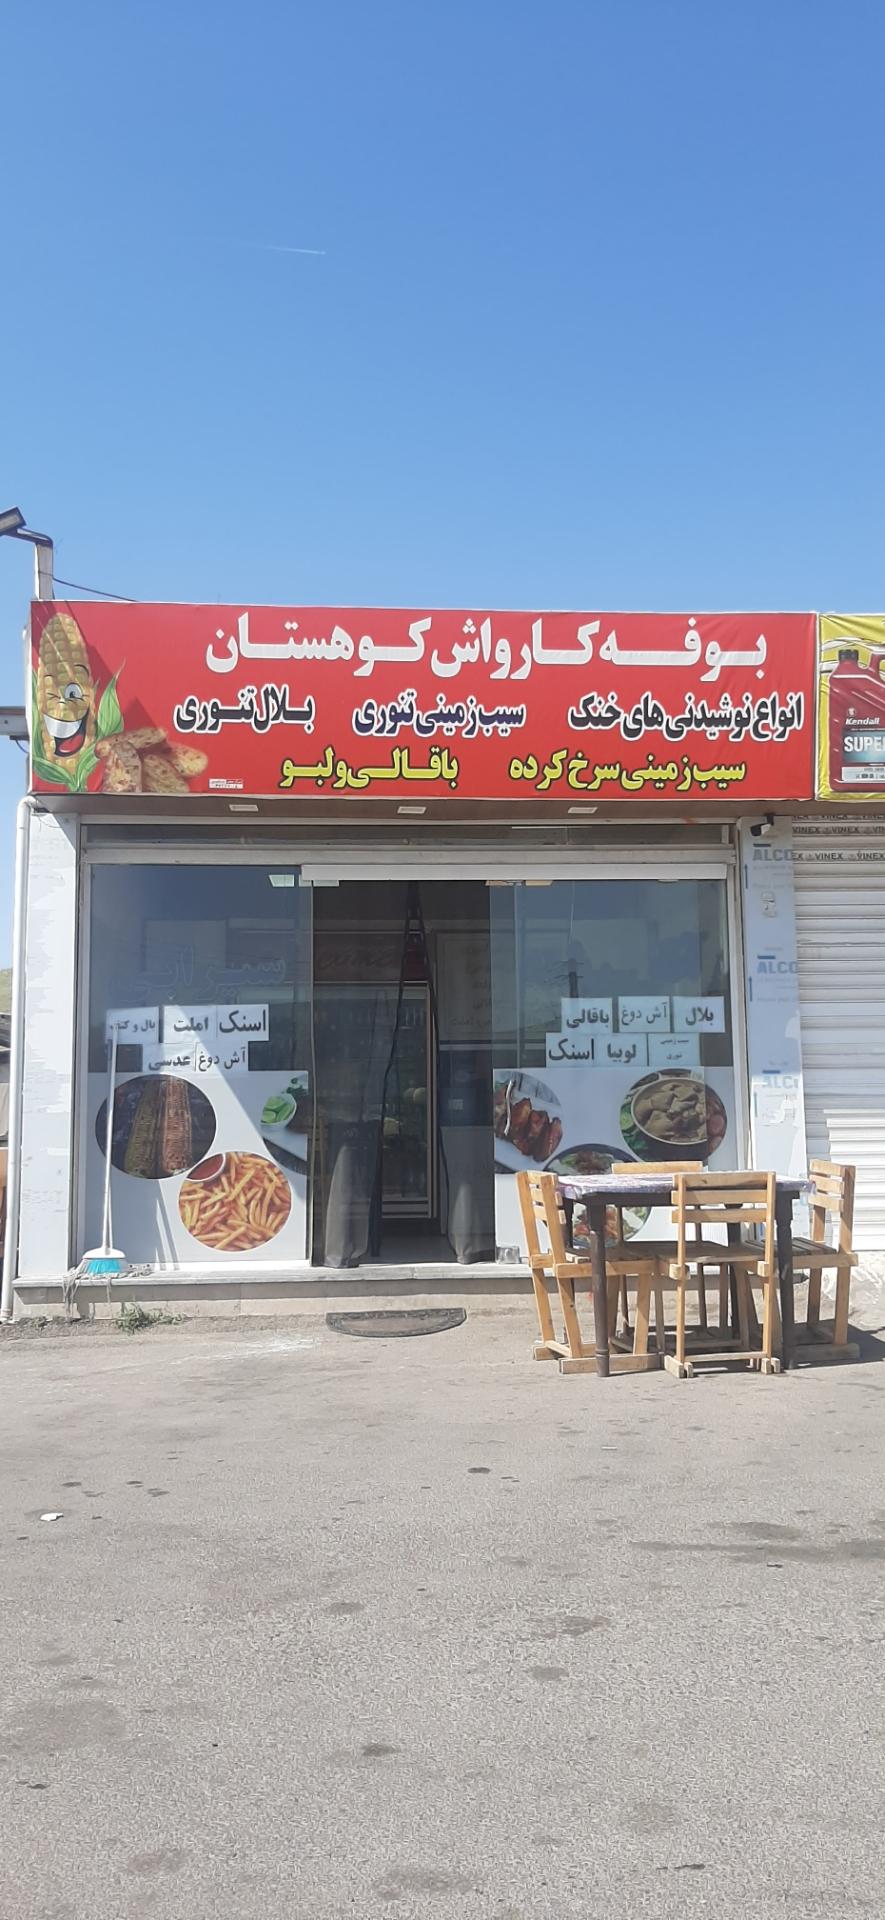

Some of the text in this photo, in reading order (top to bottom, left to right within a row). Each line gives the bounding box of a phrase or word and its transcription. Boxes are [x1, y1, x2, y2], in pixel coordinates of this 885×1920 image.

[205, 611, 767, 682] بوفه کارواش کوهستان
[173, 683, 315, 735] بلال تنوری
[352, 688, 527, 738] سیب زمینی تنوری
[567, 691, 805, 742] انواع نوشیدنی های خنک
[845, 717, 881, 726] Kendall
[844, 736, 885, 753] SUPE
[347, 746, 460, 789] باقالی
[509, 749, 747, 791] سیب زمینی سرخ کرده
[831, 826, 860, 835] VINEX
[815, 852, 844, 861] VINEX
[172, 1015, 209, 1033] املت
[218, 1008, 267, 1034] اسنک
[566, 1007, 610, 1029] باقالی
[620, 1001, 667, 1026] آش دوغ
[685, 1006, 714, 1027] بلال
[198, 1046, 247, 1071] آش دوغ
[548, 1038, 595, 1061] اسنک
[607, 1043, 637, 1064] لوبیا
[148, 1054, 191, 1072] عدسی
